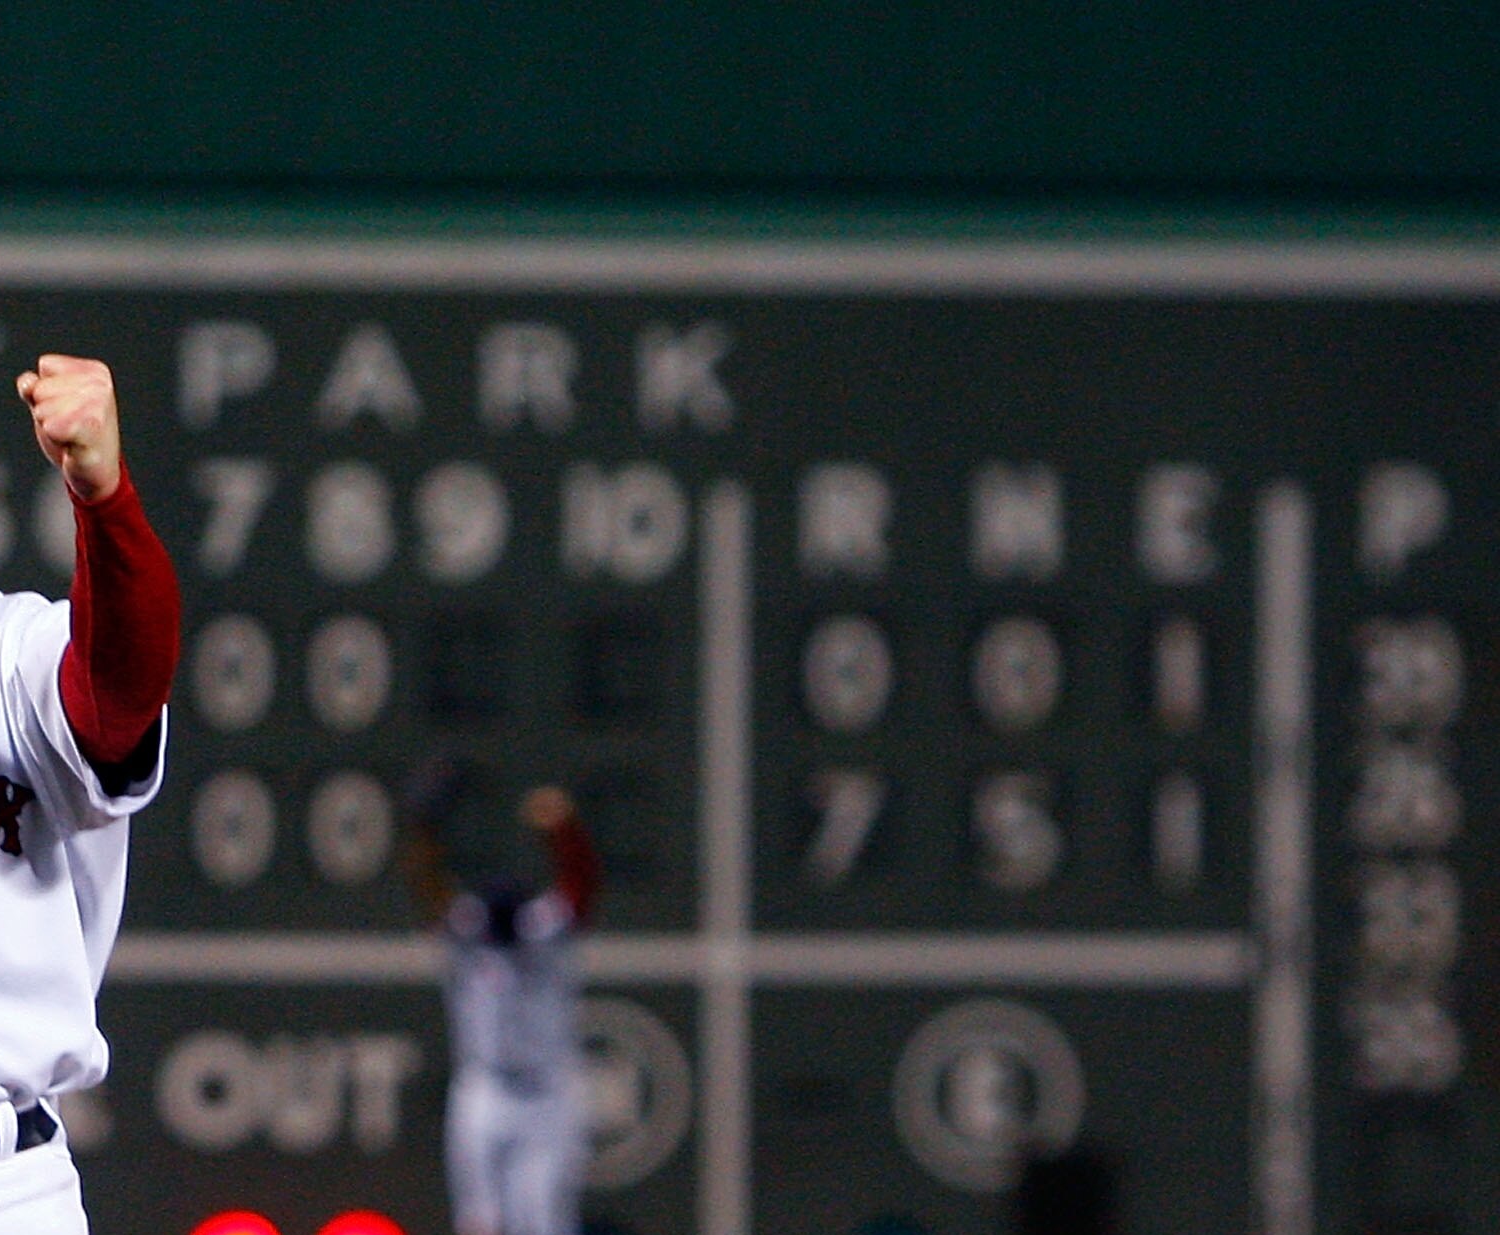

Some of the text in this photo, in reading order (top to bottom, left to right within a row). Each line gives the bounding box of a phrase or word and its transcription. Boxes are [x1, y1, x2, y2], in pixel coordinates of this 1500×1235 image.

[180, 321, 734, 423] PARK
[198, 459, 270, 573] 7
[414, 463, 502, 579] 9
[562, 463, 684, 579] 10
[196, 617, 272, 727] 0
[308, 617, 388, 727] 0
[806, 619, 888, 727] 0
[978, 619, 1058, 727] 0
[198, 775, 390, 883] 0 0
[812, 775, 886, 883] 7
[159, 1035, 418, 1147] OUT
